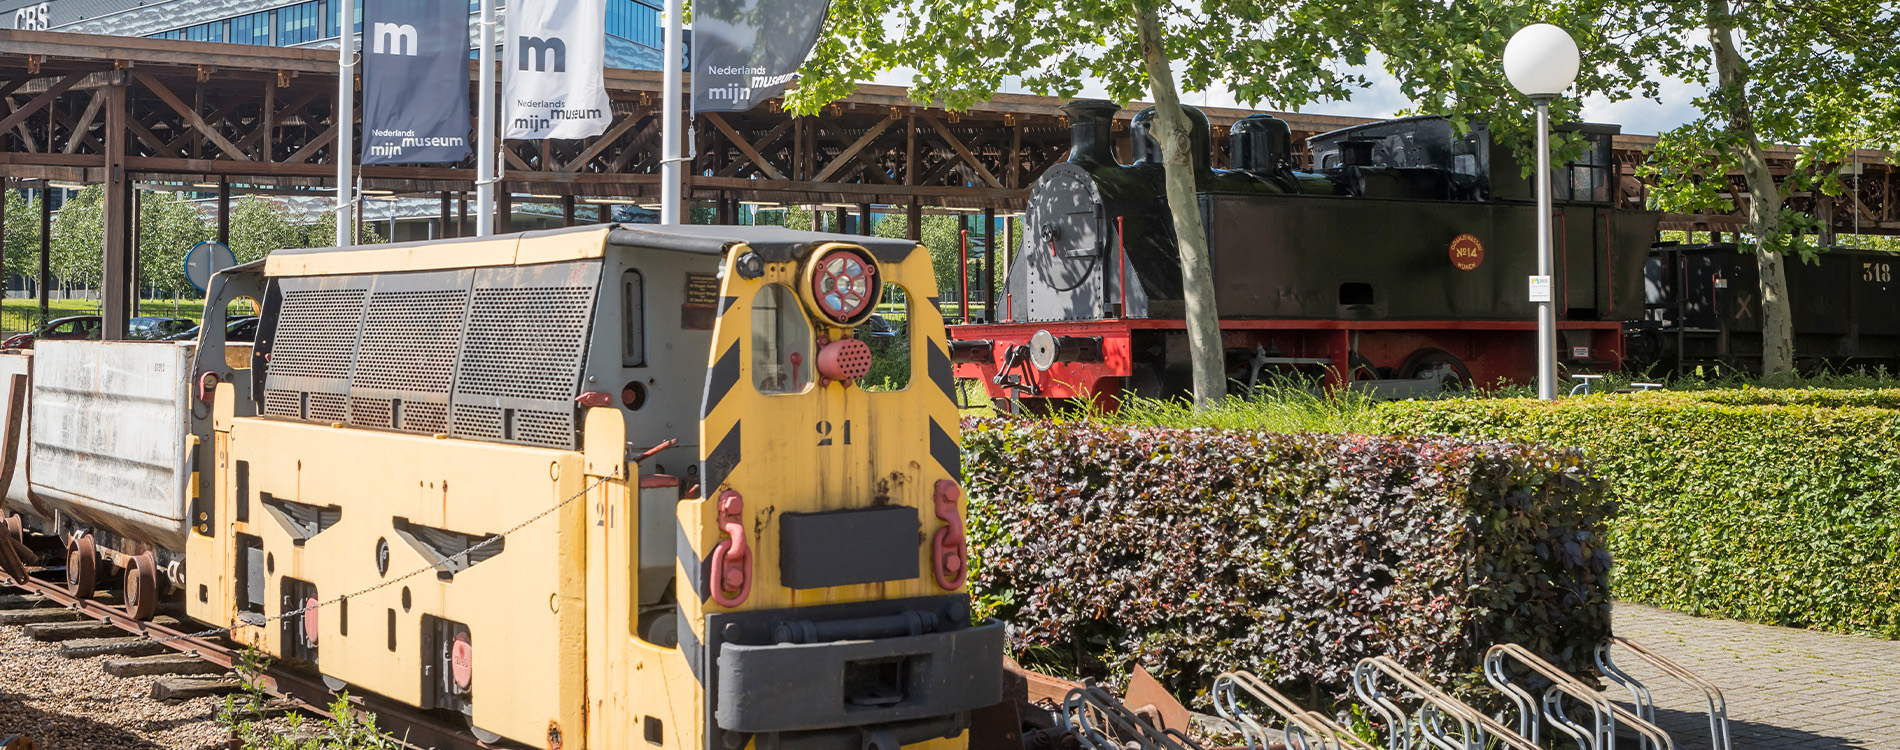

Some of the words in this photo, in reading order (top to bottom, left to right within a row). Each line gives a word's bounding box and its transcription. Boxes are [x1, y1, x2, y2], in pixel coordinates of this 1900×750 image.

[15, 2, 49, 31] CBS
[373, 22, 418, 56] m
[518, 35, 566, 73] m
[708, 65, 766, 75] Nederlands
[708, 82, 751, 104] mijn
[751, 71, 796, 89] museum
[517, 99, 566, 108] Nederlands
[371, 129, 415, 137] Nederlands
[514, 114, 550, 132] mijn
[550, 108, 602, 120] museum
[370, 142, 402, 159] mijn
[401, 136, 464, 148] museum
[1863, 262, 1891, 283] 318
[816, 419, 852, 447] 21
[596, 501, 614, 529] 21
